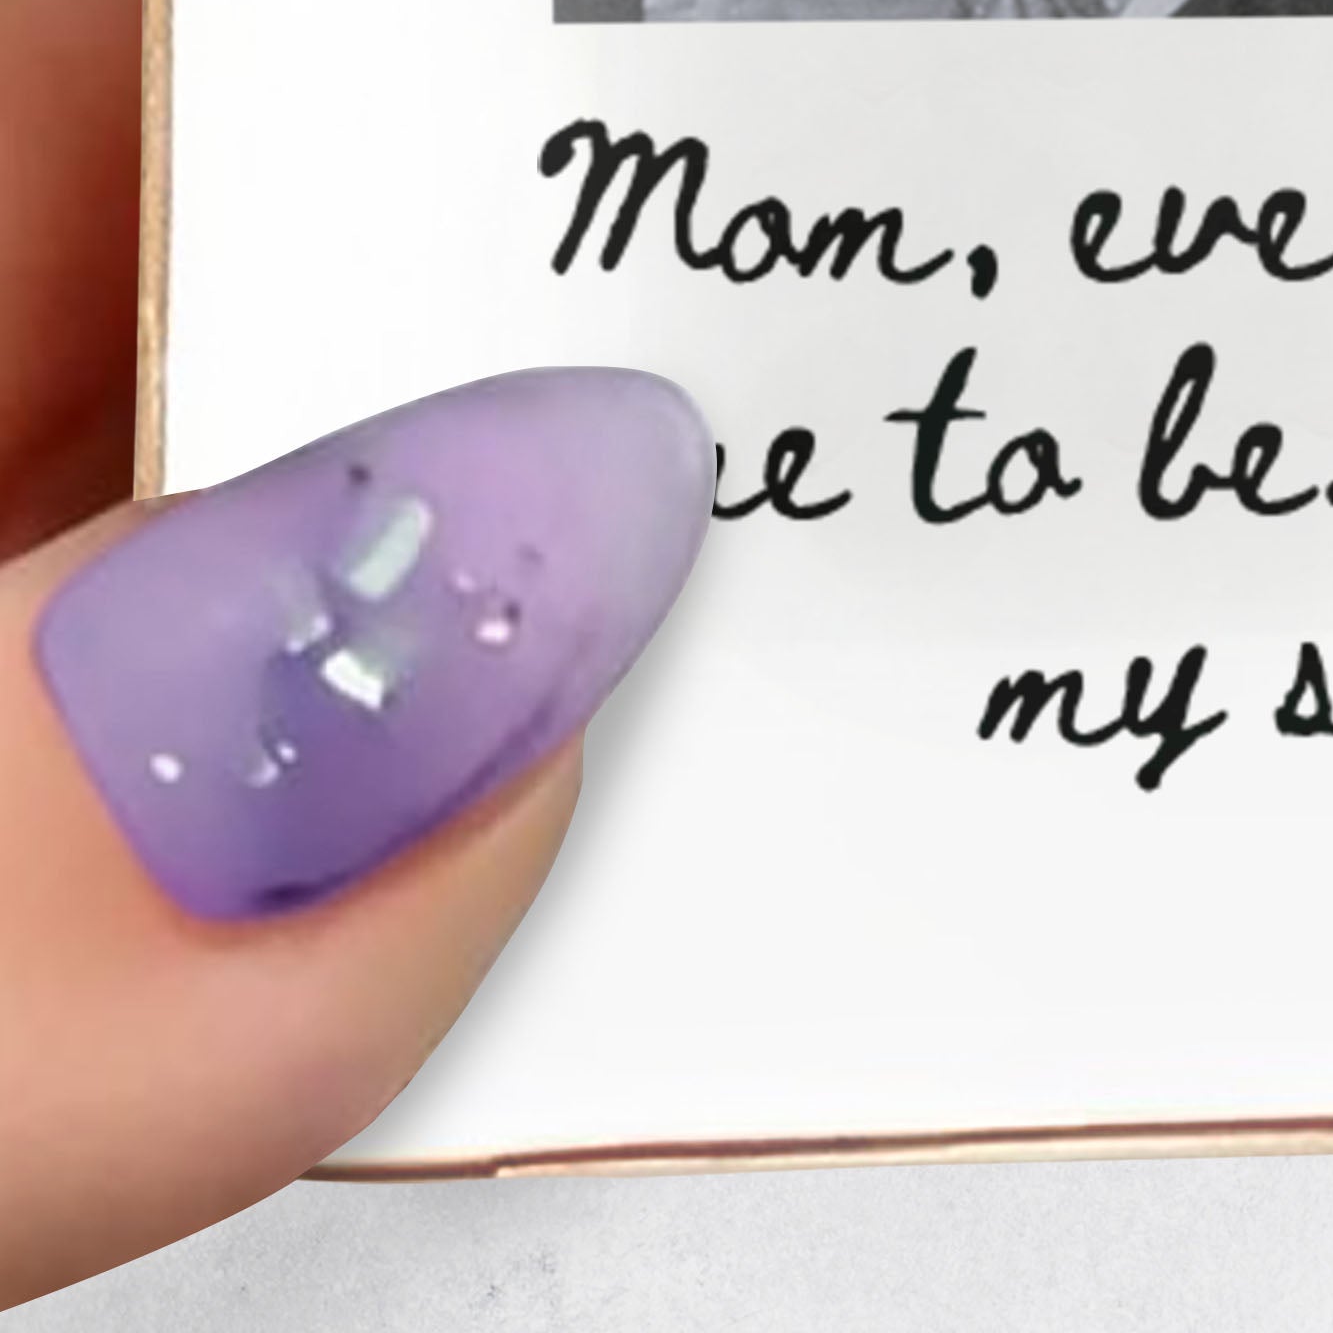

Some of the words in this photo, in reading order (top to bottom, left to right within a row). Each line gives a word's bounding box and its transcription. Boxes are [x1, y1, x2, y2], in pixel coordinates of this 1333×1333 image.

[538, 119, 999, 300] Mom,
[710, 425, 853, 521] e
[883, 345, 1084, 525] to
[977, 644, 1229, 793] my
